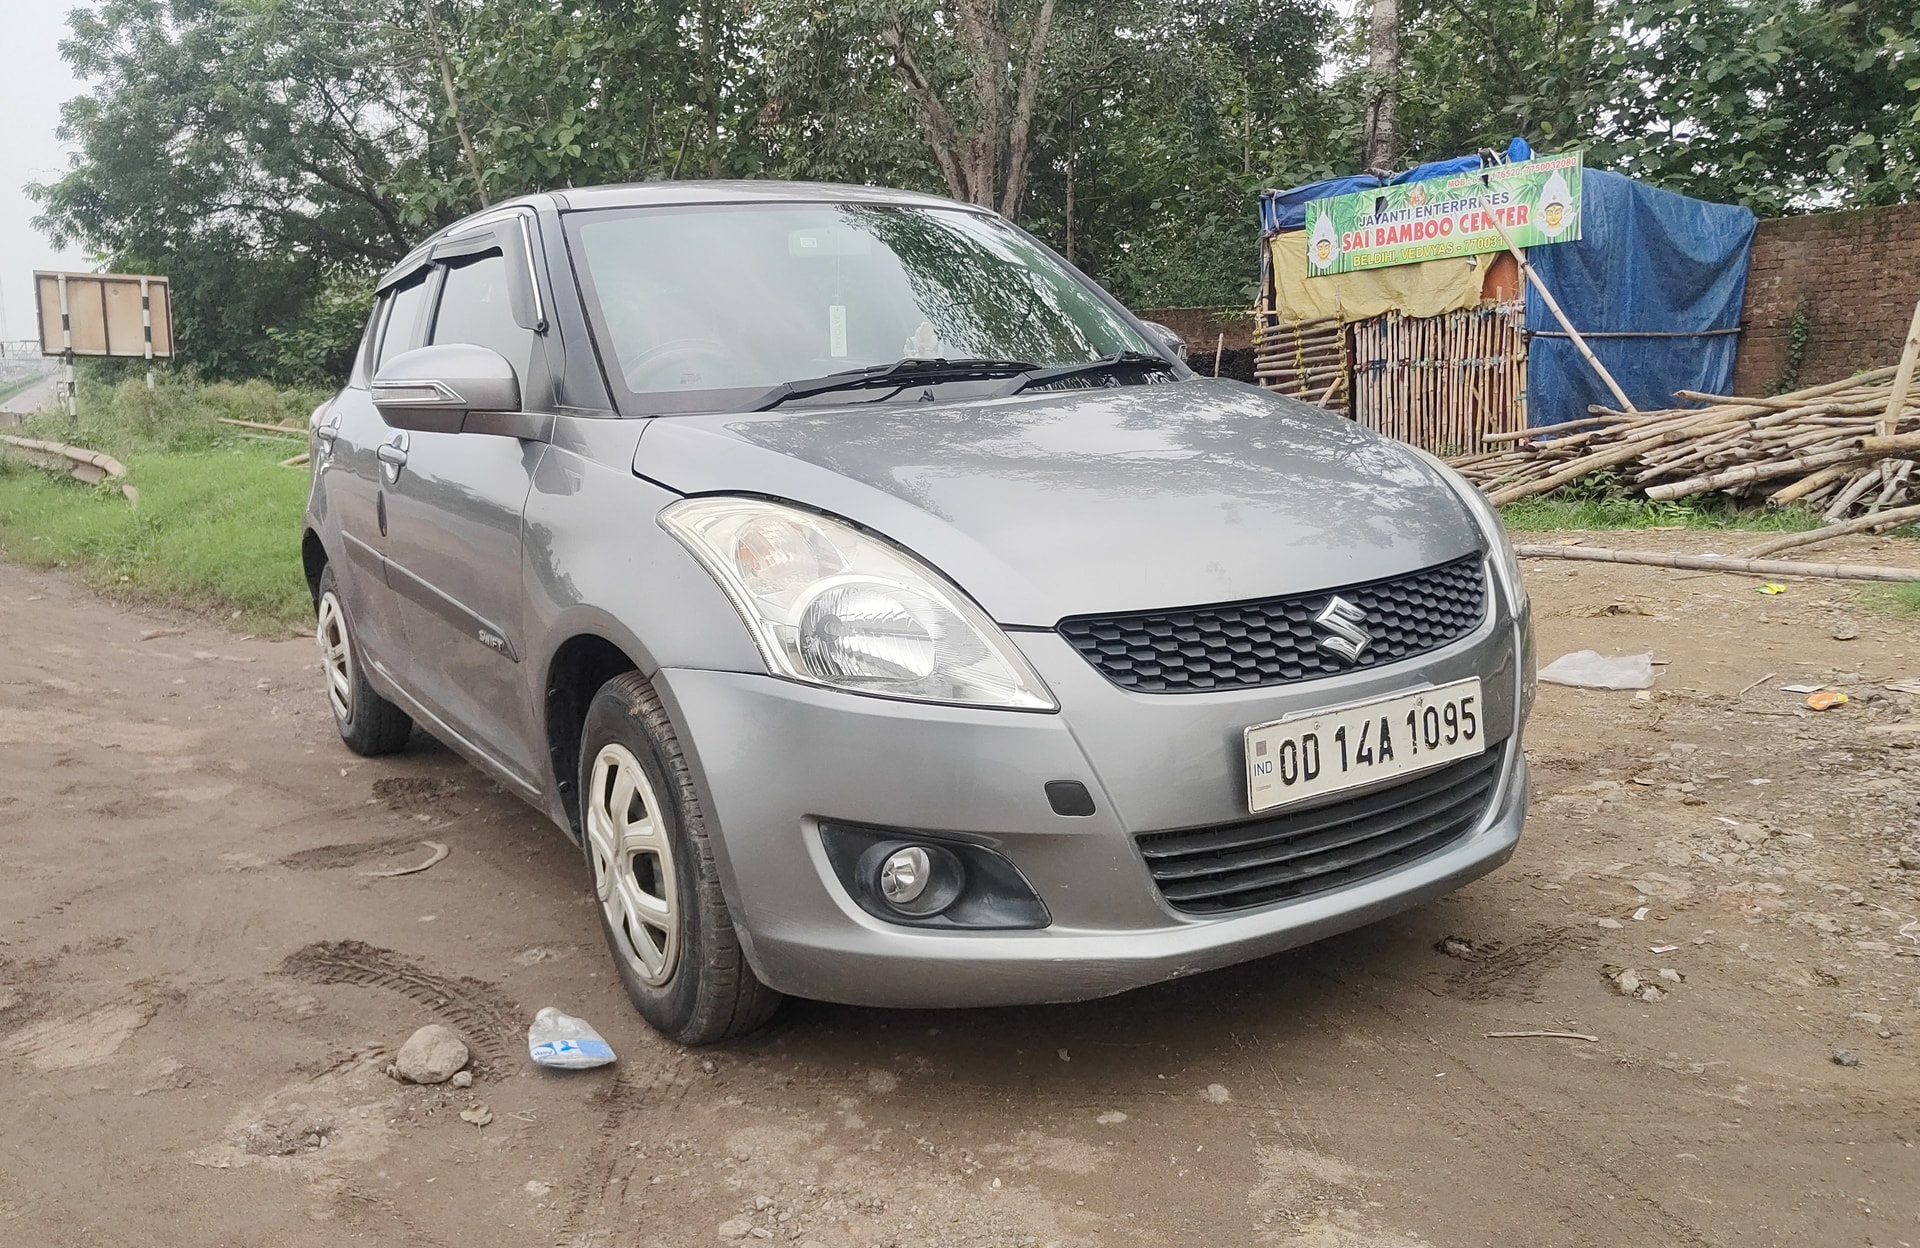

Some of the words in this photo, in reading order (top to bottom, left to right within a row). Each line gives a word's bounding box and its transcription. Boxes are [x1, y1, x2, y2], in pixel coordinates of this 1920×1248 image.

[1447, 179, 1466, 188] MOB
[1525, 158, 1577, 173] 7750032080
[1359, 209, 1411, 228] JAYANTI
[1416, 191, 1510, 219] ENTERPRISES
[1342, 230, 1369, 252] SAI
[1376, 217, 1453, 247] BAMBOO
[1459, 205, 1528, 234] CENTER
[1353, 252, 1398, 267] BELDIHI,
[1401, 243, 1454, 260] VEDVYAS
[1464, 236, 1504, 251] 770031
[1279, 732, 1321, 786] OD
[1334, 716, 1394, 772] 14A
[1406, 697, 1477, 755] 1095
[1253, 760, 1273, 777] IND
